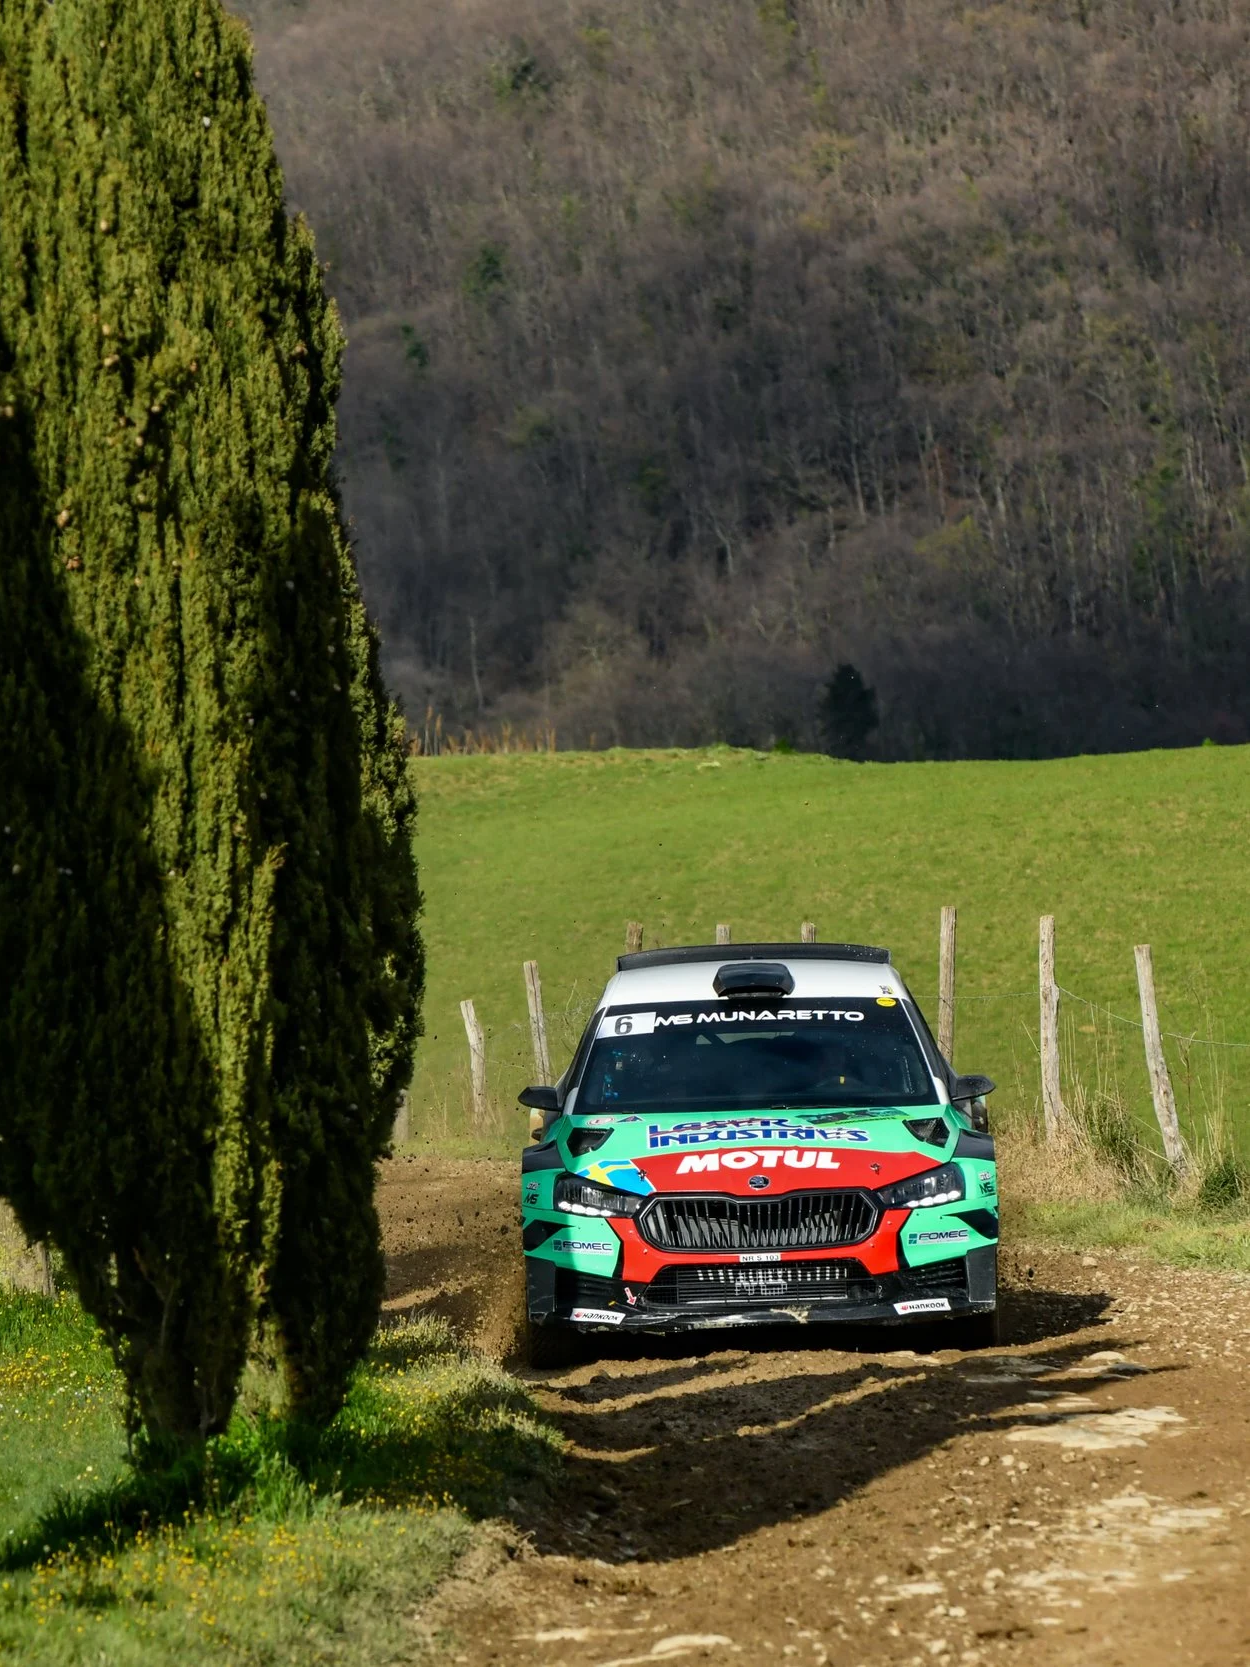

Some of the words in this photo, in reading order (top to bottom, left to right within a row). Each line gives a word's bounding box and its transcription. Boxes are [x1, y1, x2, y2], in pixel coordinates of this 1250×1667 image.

[614, 1015, 633, 1035] 6
[654, 1014, 693, 1027] MS
[696, 1010, 865, 1024] MUNARETTO
[649, 1127, 869, 1148] INDUSTRIES
[675, 1150, 841, 1174] MOTUL
[919, 1229, 968, 1241] FOMEC
[563, 1241, 613, 1251] FOMEC
